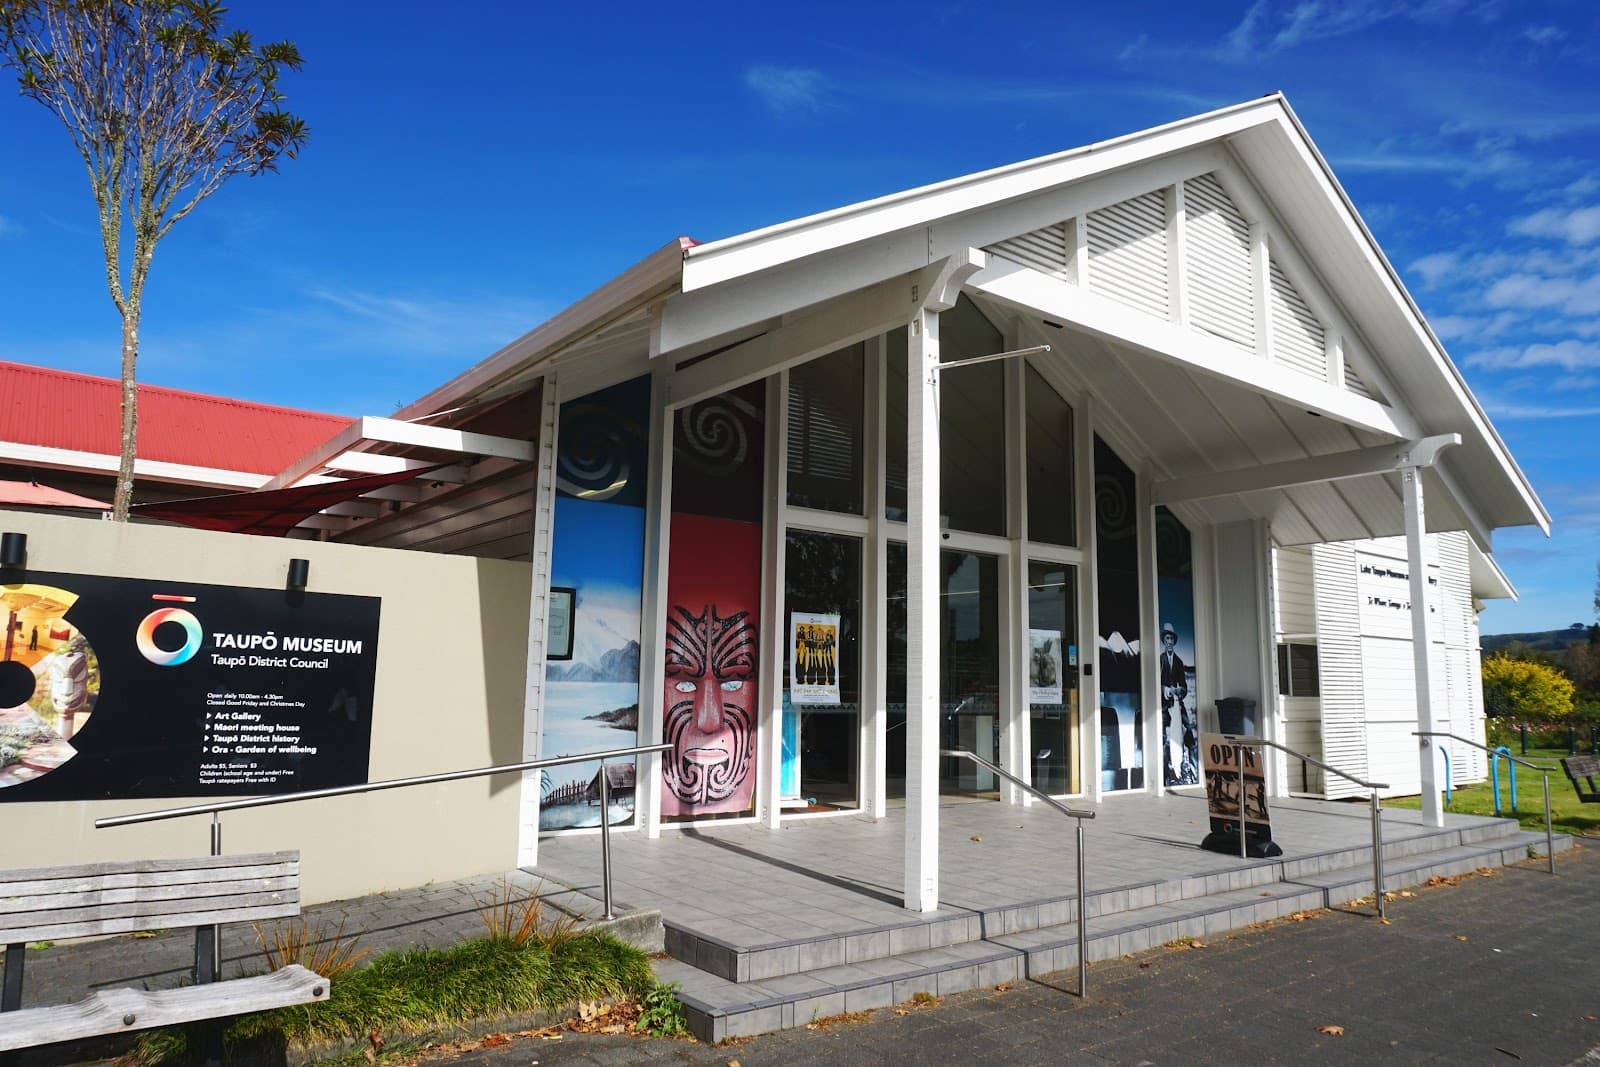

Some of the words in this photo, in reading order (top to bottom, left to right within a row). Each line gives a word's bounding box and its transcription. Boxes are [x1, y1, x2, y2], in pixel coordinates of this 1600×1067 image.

[212, 631, 278, 650] TAUPŌ
[282, 636, 363, 654] MUSEUM
[210, 654, 246, 669] Taupō
[248, 656, 287, 668] District
[289, 657, 329, 669] Council
[207, 692, 222, 700] Open
[215, 712, 230, 720] Art
[231, 712, 261, 722] Gallery
[240, 724, 274, 733] meeting
[276, 724, 300, 732] house
[240, 734, 270, 743] District
[272, 735, 300, 744] history
[235, 746, 266, 754] Garden
[268, 745, 277, 753] of
[278, 746, 317, 755] wellbeing
